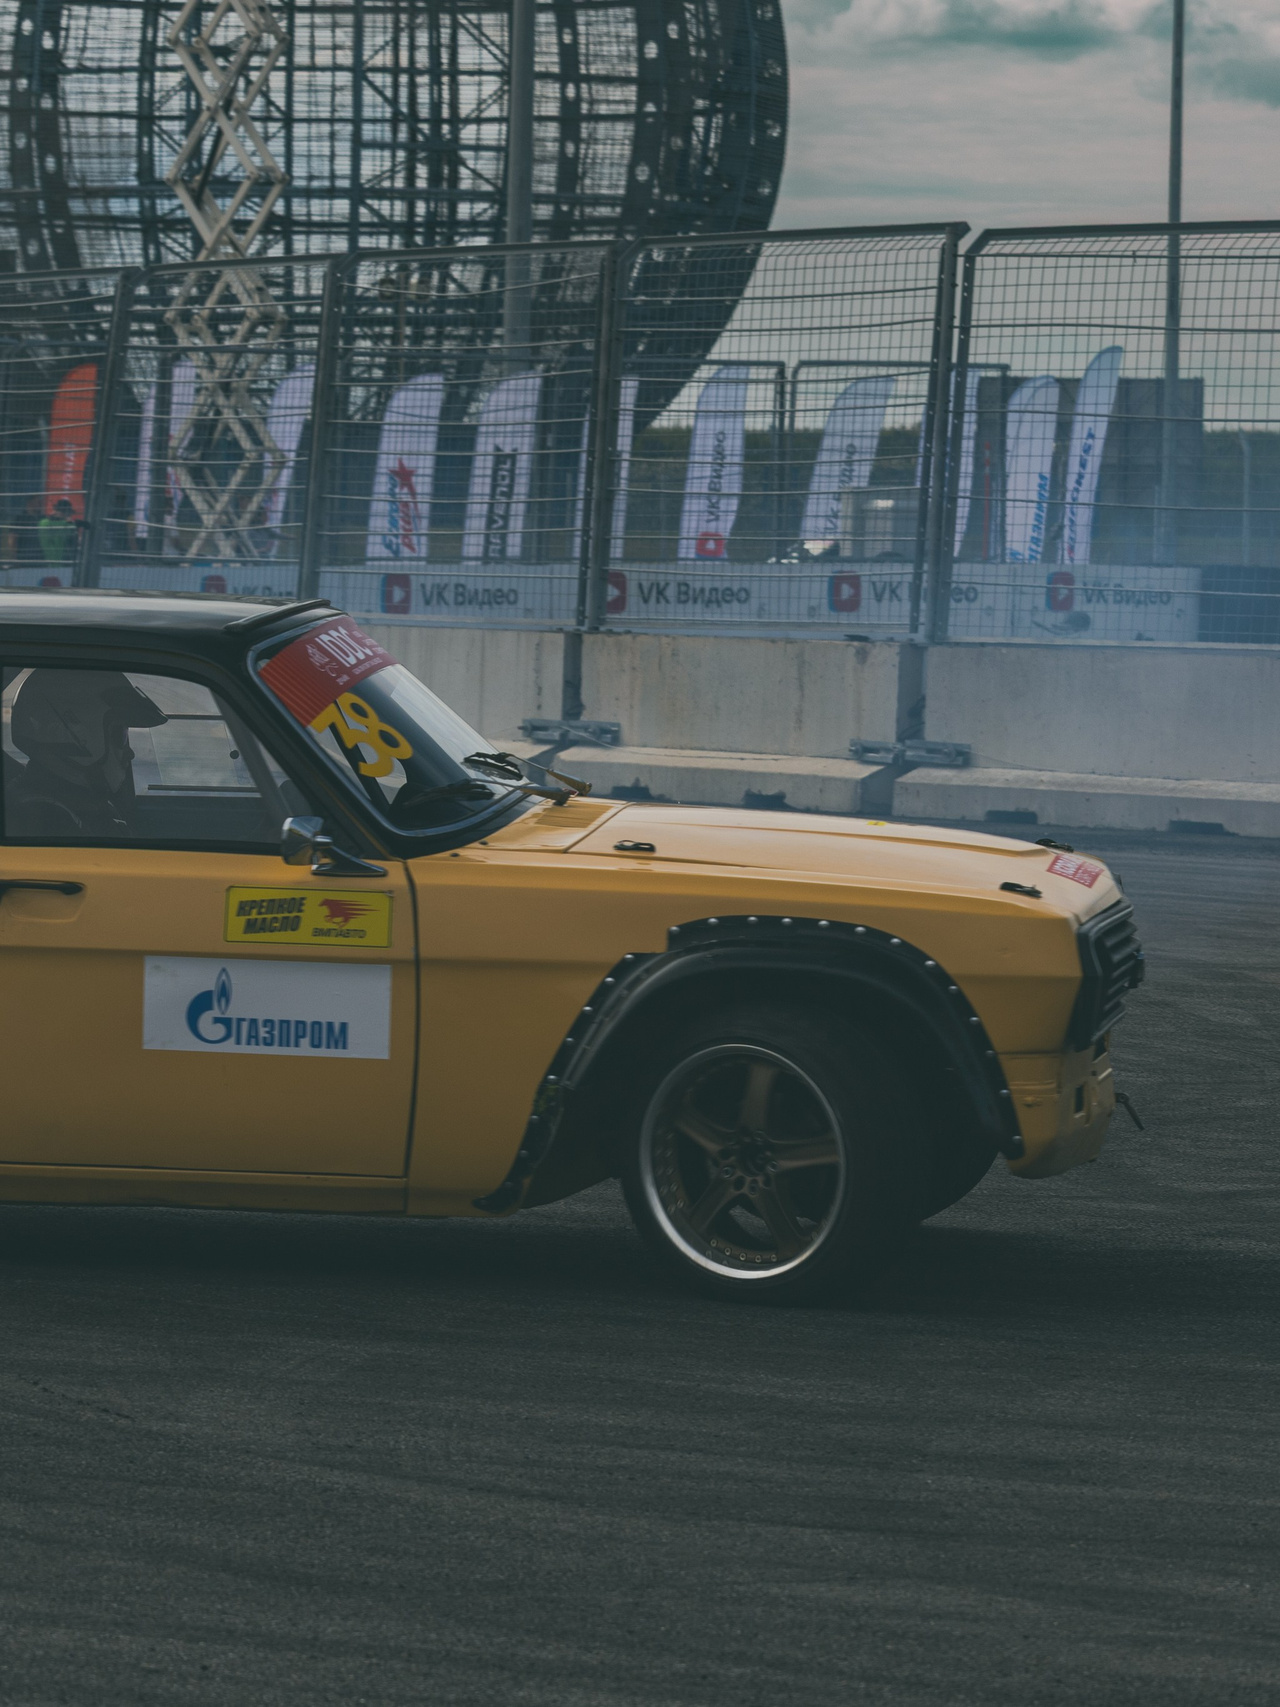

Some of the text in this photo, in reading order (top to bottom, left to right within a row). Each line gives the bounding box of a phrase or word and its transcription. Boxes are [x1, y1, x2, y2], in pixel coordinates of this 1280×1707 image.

[421, 583, 519, 608] VK Видео
[637, 582, 751, 608] VK Видео
[871, 581, 902, 603] VK
[314, 626, 374, 668] IDDC
[310, 691, 413, 778] 38
[236, 897, 307, 917] КРЕПКОЕ
[243, 915, 302, 934] МАСЛО
[233, 1016, 350, 1050] ГАЗПРОМ
